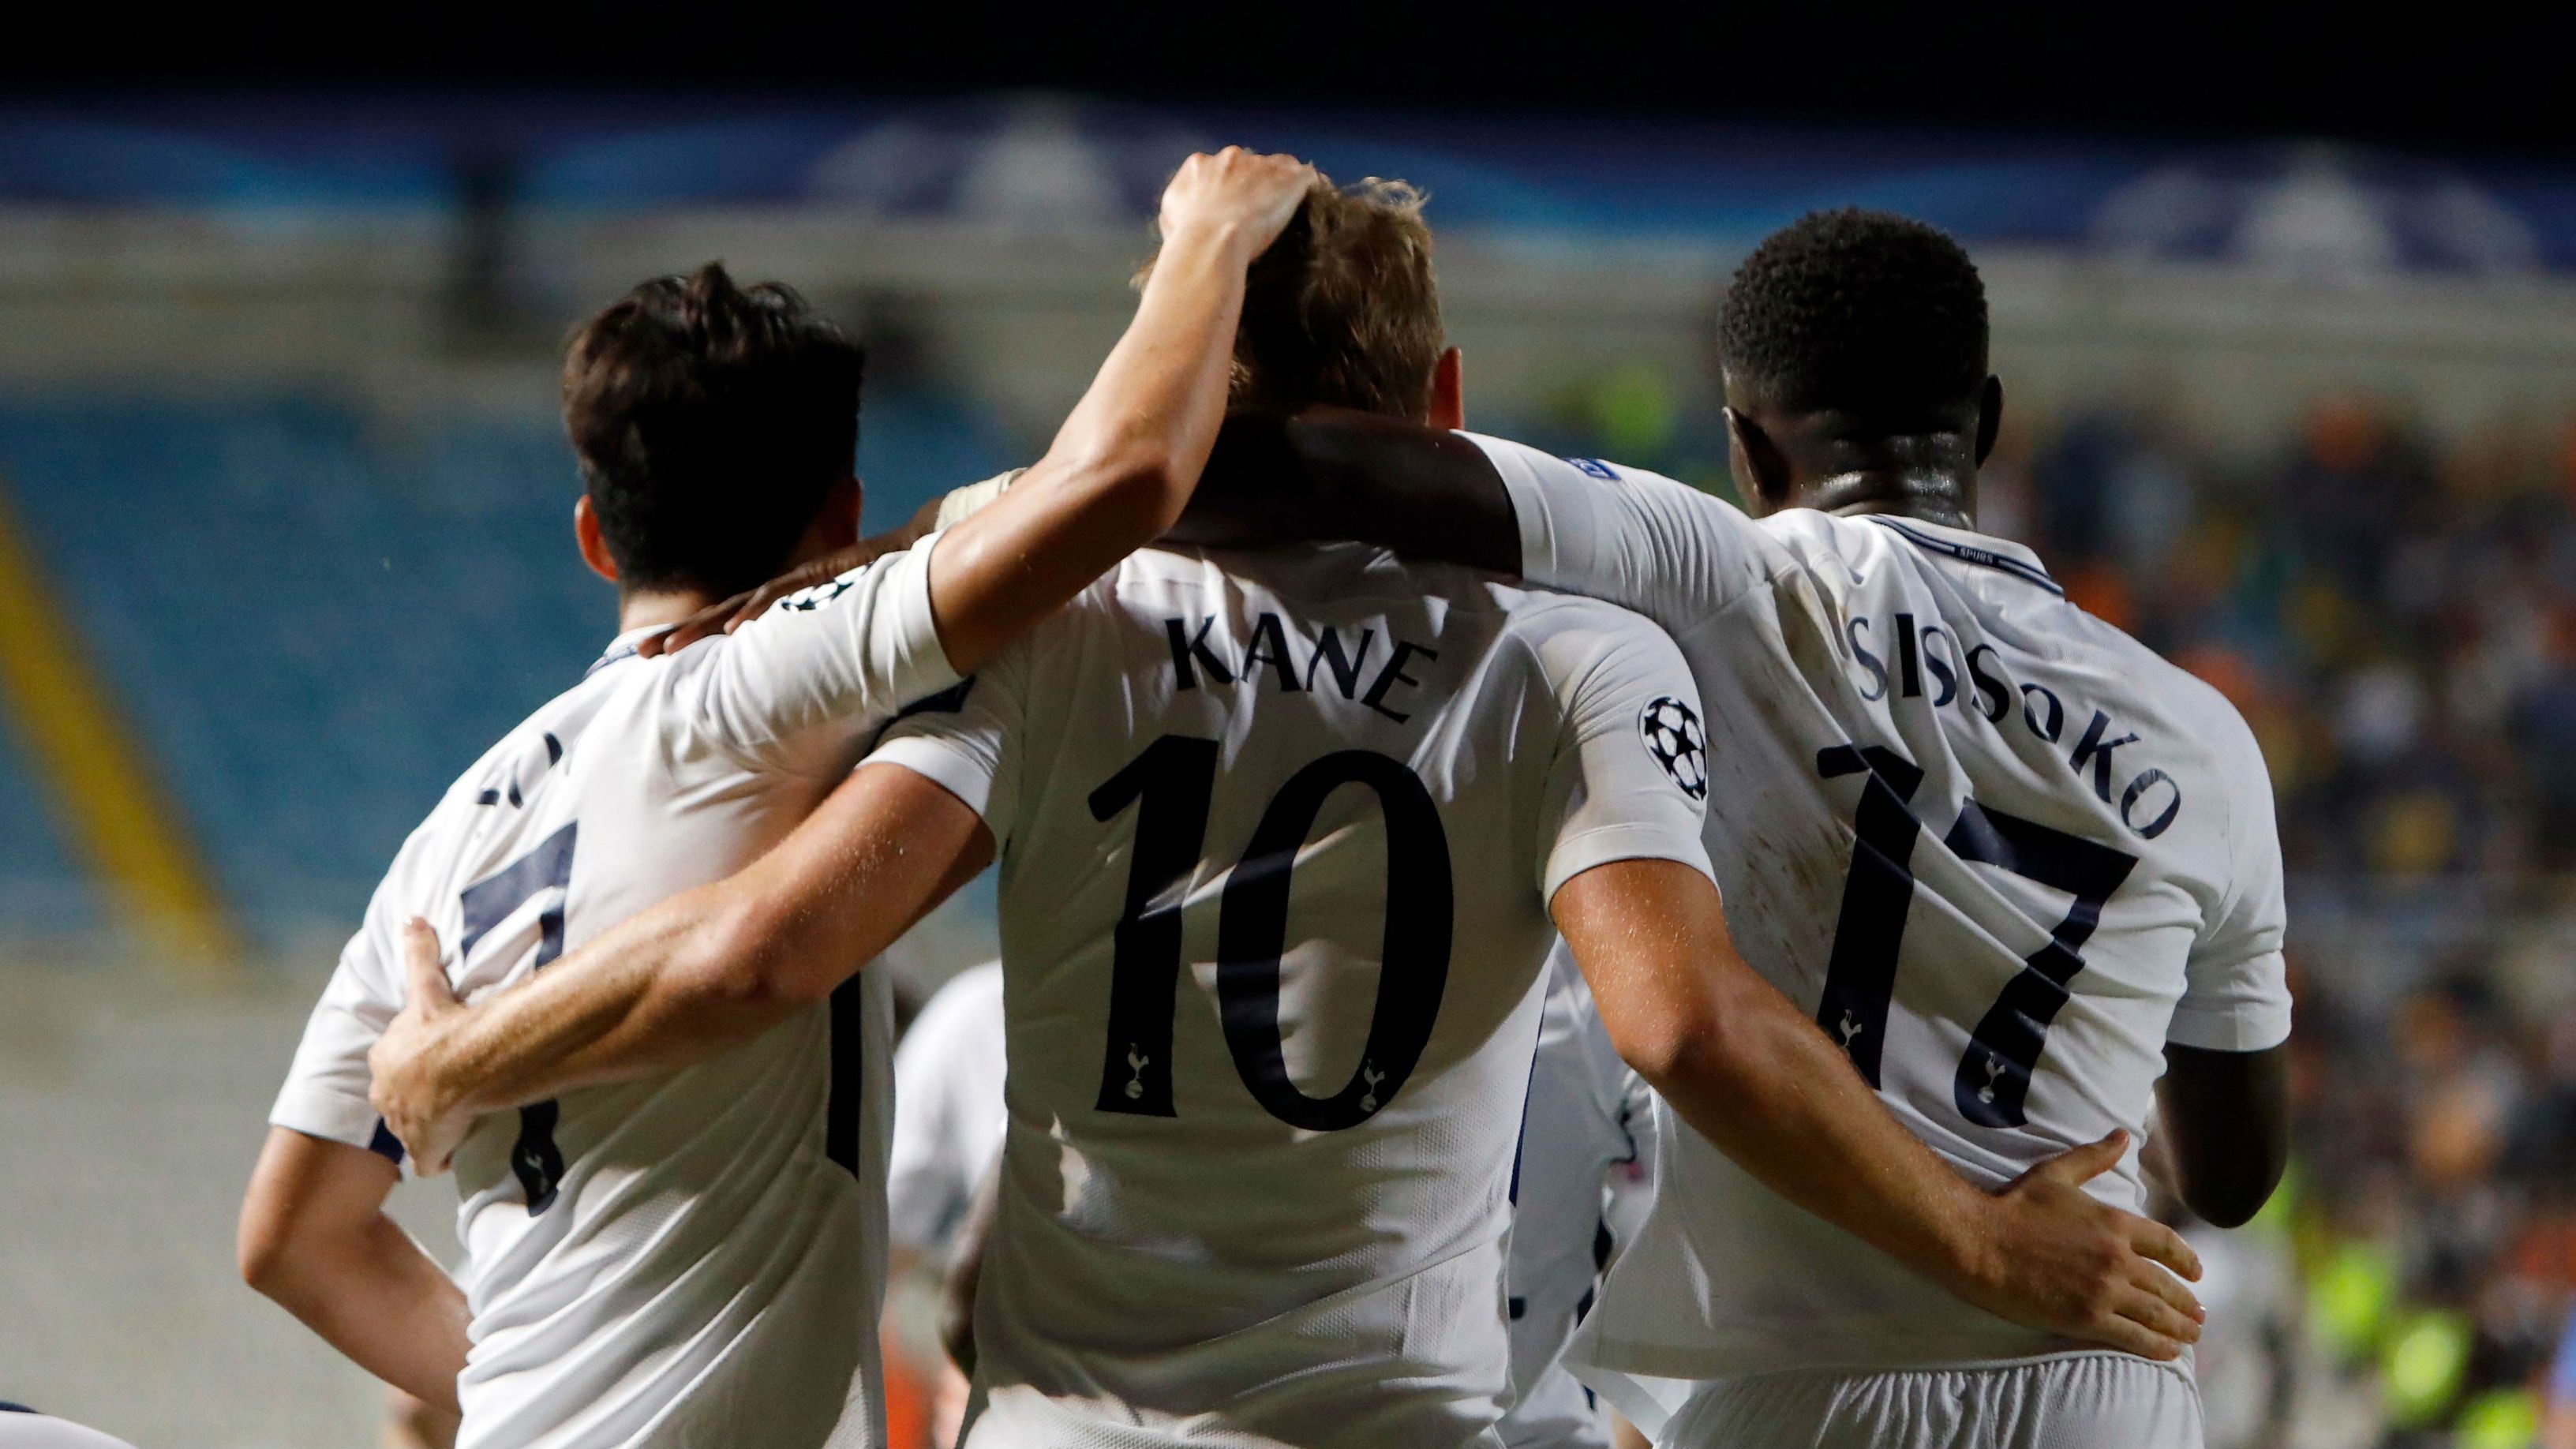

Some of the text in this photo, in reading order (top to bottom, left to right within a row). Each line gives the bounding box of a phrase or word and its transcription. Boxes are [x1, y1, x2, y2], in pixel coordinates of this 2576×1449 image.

[1164, 612, 1439, 724] KANE
[1959, 546, 1994, 565] SPURS
[1847, 612, 2182, 841] SISSOKO
[1088, 734, 1455, 1133] 10
[1816, 743, 2140, 1129] 17
